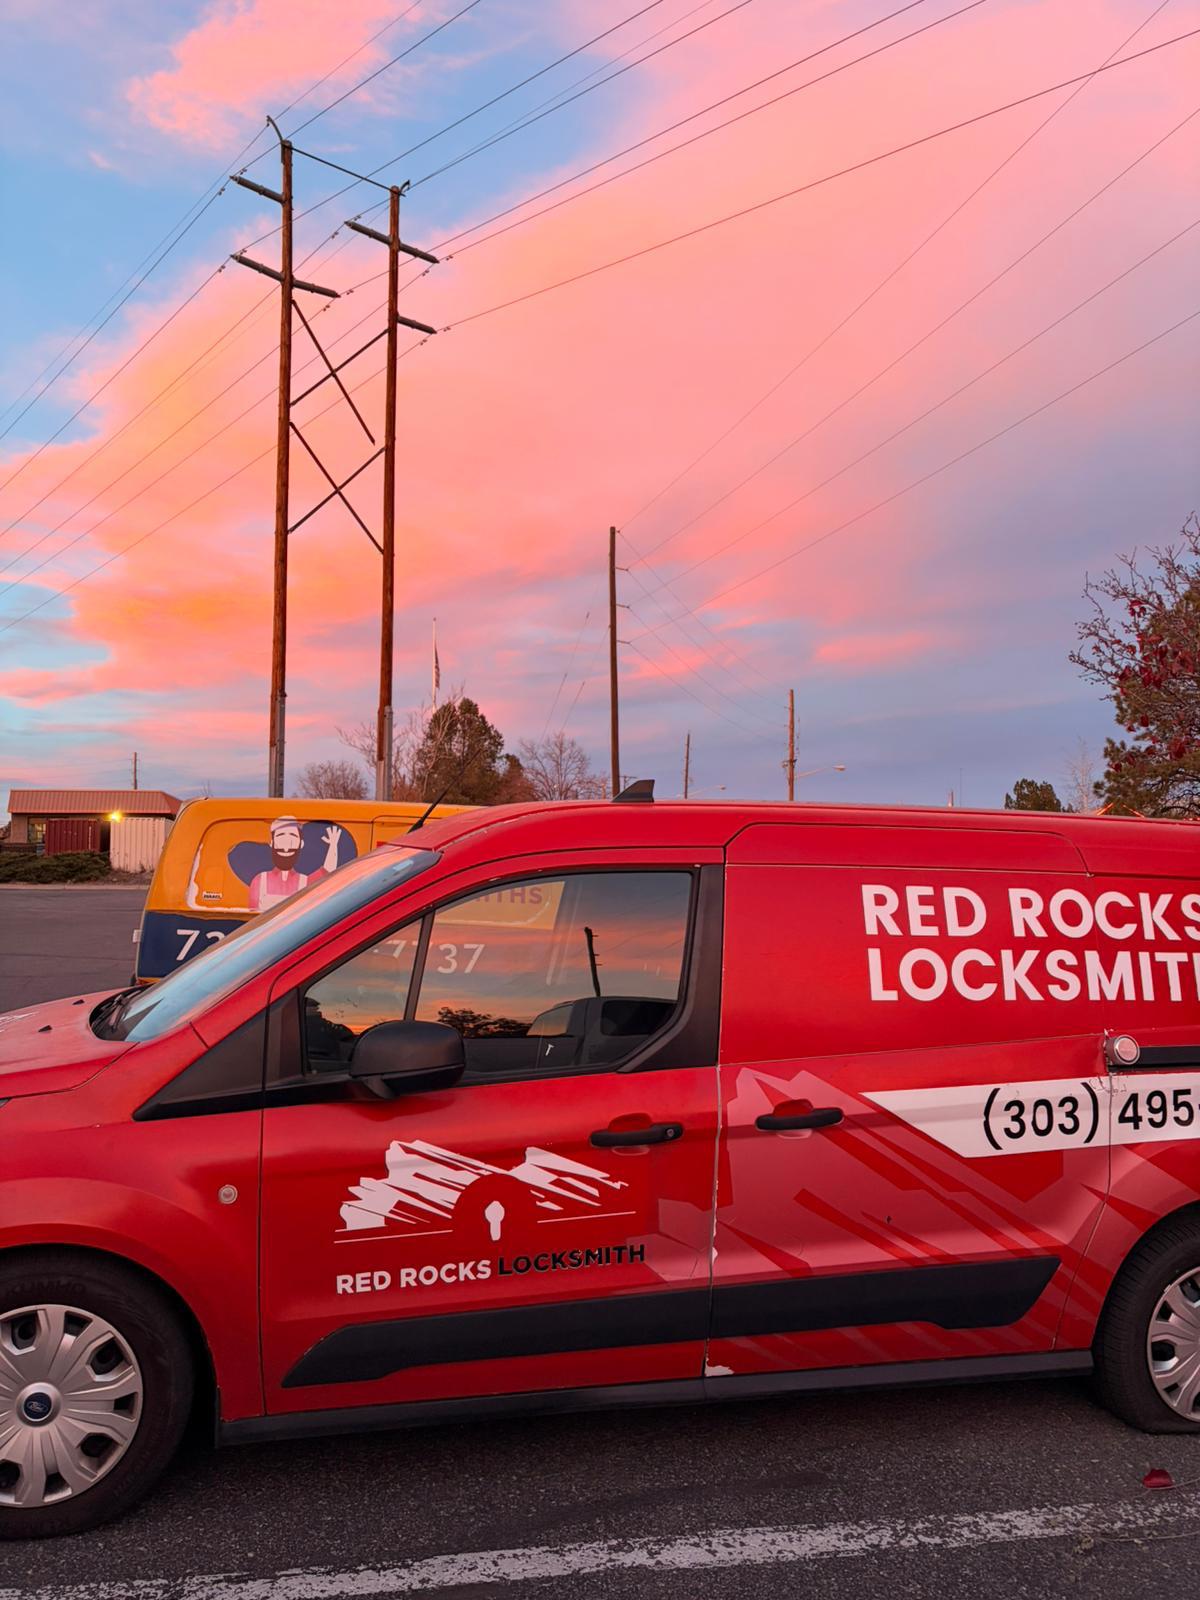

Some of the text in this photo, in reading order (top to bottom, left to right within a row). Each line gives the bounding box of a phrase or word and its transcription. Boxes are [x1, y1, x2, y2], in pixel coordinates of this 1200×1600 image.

[861, 884, 1200, 941] RED ROCKS
[868, 948, 1200, 1001] LOCKSMIT
[983, 1081, 1099, 1150] (303)
[336, 1244, 645, 1294] RED ROCKS LOCKSMITH
